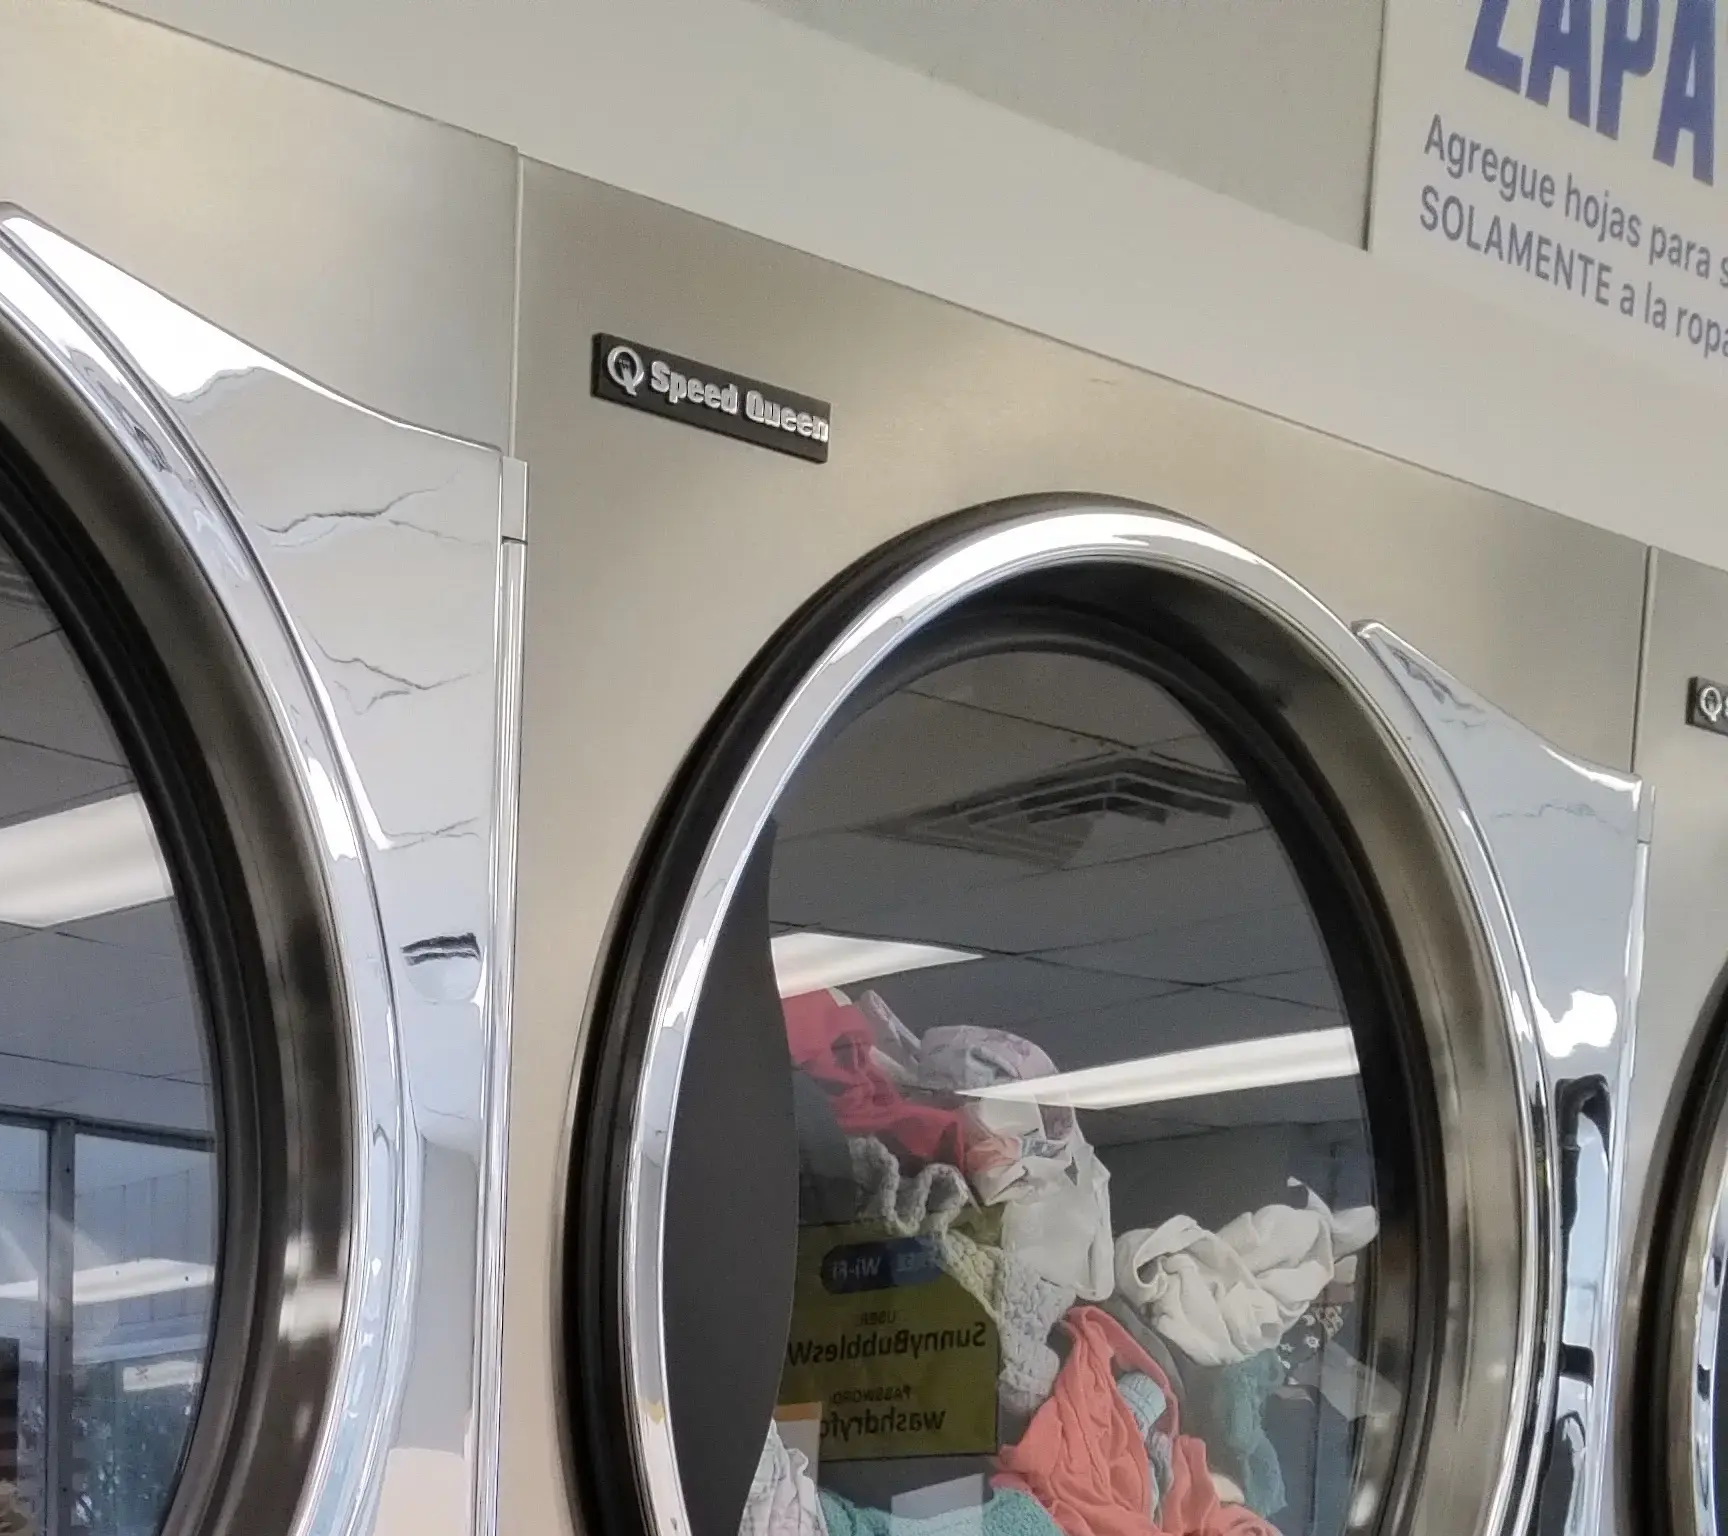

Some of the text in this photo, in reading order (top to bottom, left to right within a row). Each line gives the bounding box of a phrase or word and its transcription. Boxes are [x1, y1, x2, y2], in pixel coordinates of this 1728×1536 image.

[1421, 185, 1612, 306] SOLAMENTE
[1620, 284, 1635, 316] a
[1645, 281, 1666, 331] la
[1424, 113, 1555, 207] Agregue
[1565, 174, 1641, 248] hojas
[1650, 224, 1710, 279] para
[651, 360, 738, 415] Speed
[745, 390, 828, 442] Queen
